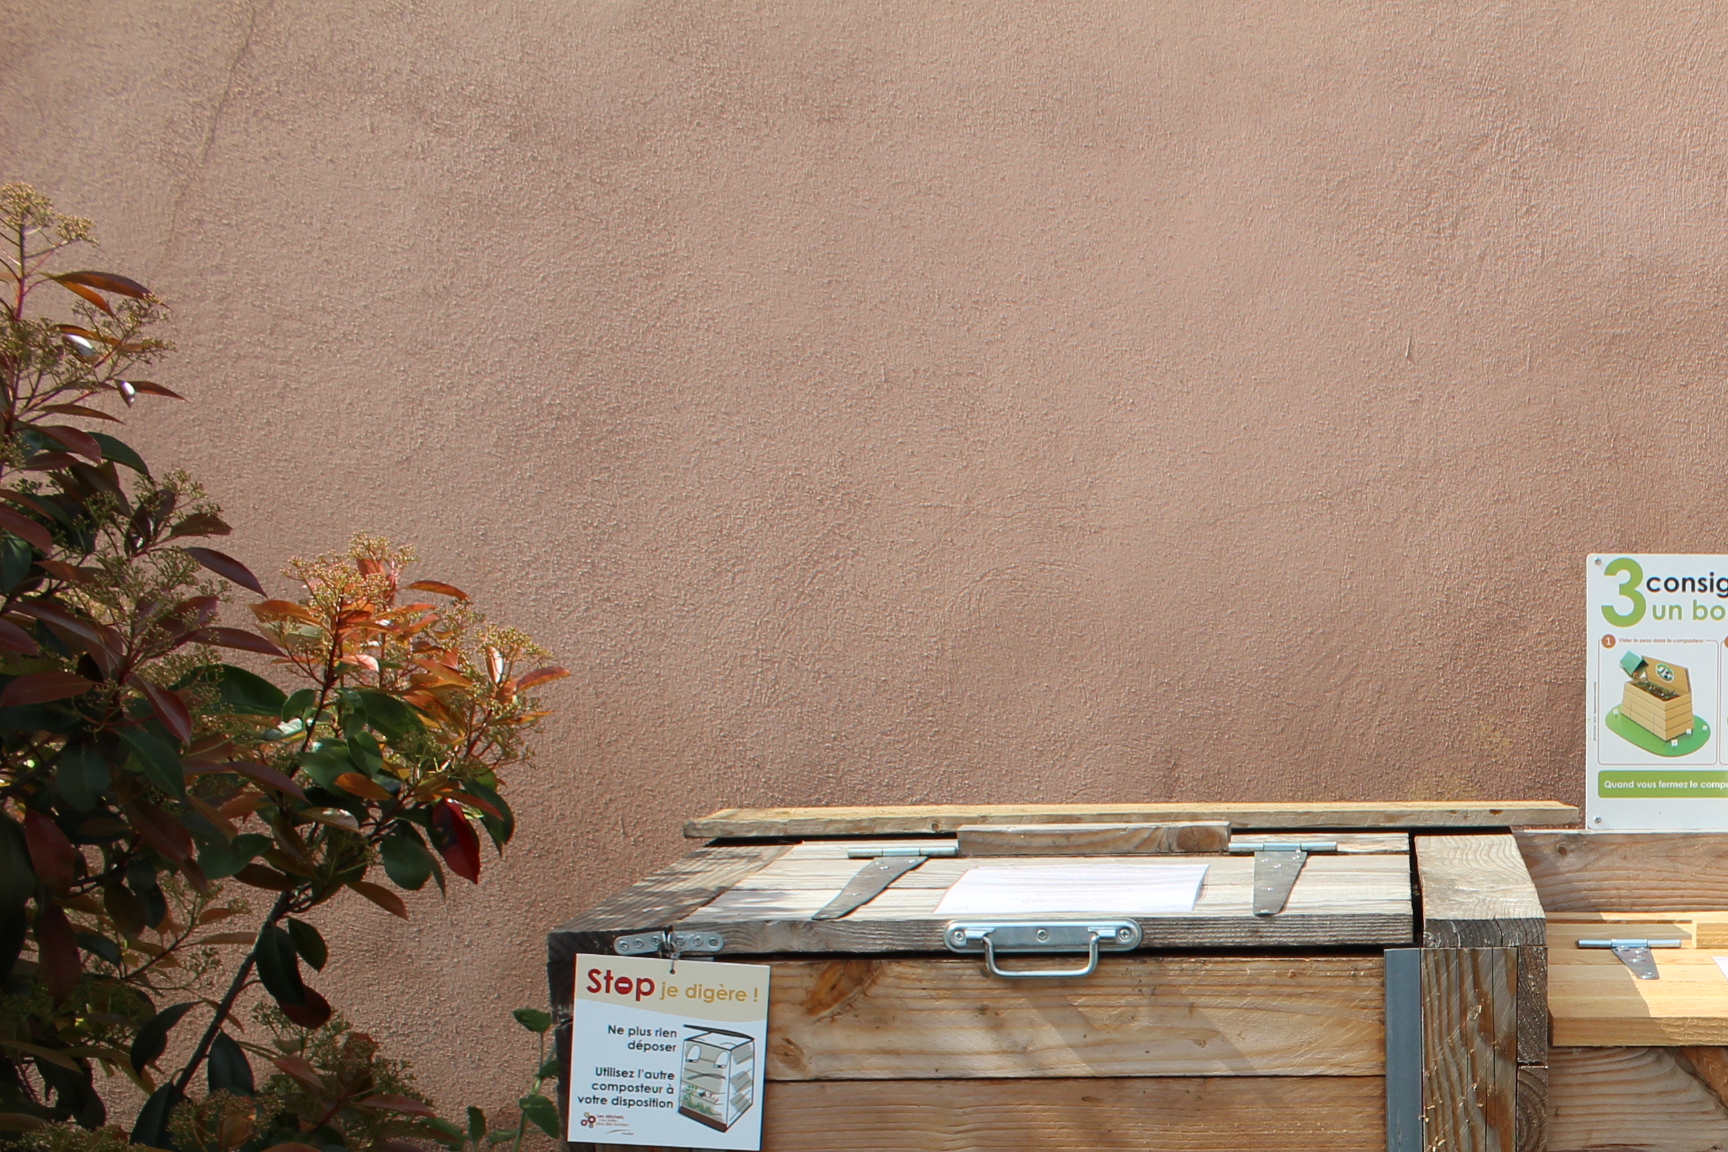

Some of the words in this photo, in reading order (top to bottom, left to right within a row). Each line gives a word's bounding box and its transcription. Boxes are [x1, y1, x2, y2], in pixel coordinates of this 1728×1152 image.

[1601, 557, 1647, 628] 3
[1652, 604, 1683, 621] un
[1604, 780, 1634, 789] Quand
[1636, 781, 1657, 789] vous
[1658, 780, 1688, 789] fermez
[1690, 780, 1698, 789] le
[586, 968, 655, 1002] Stop
[659, 982, 679, 1001] je
[685, 983, 747, 1003] digère
[753, 987, 759, 1002] !
[607, 1025, 625, 1035] Ne
[628, 1025, 652, 1039] plus
[654, 1027, 678, 1038] rien
[627, 1040, 677, 1054] déposer
[595, 1066, 634, 1079] Utilisez
[637, 1068, 675, 1080] l'autre
[591, 1082, 663, 1098] composteur
[666, 1083, 675, 1095] à
[577, 1095, 608, 1105] votre
[611, 1095, 674, 1109] disposition
